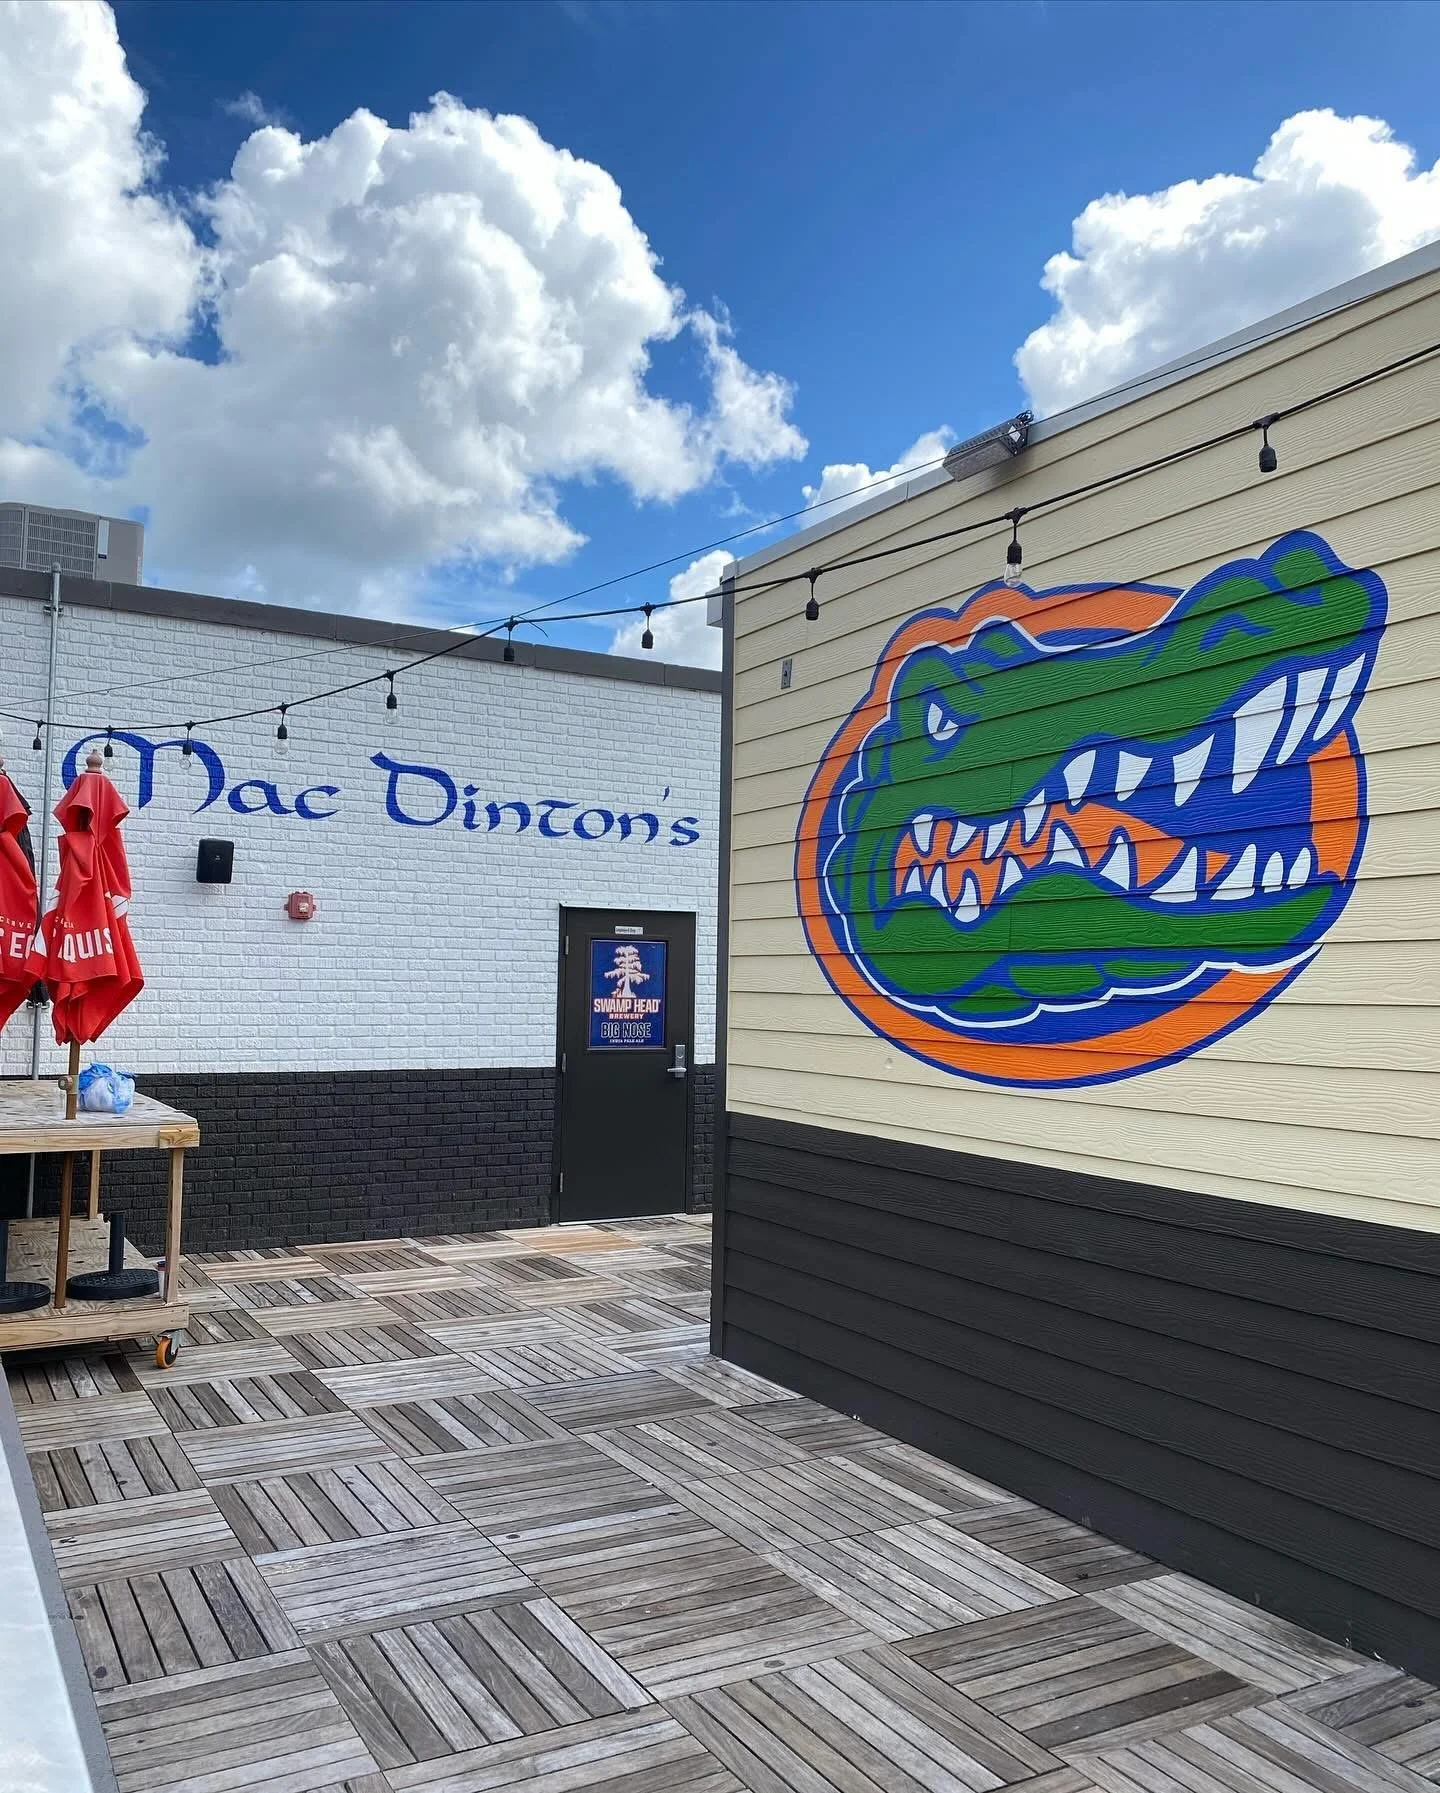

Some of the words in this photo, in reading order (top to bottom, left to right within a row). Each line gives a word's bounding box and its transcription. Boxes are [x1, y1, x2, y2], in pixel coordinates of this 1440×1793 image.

[61, 731, 341, 819] Mac
[369, 751, 700, 846] Dinton's
[58, 927, 114, 963] QUIS
[593, 998, 632, 1013] SWAMP
[633, 999, 660, 1014] HEAD
[601, 1022, 620, 1039] BIG
[622, 1022, 652, 1039] NOSE
